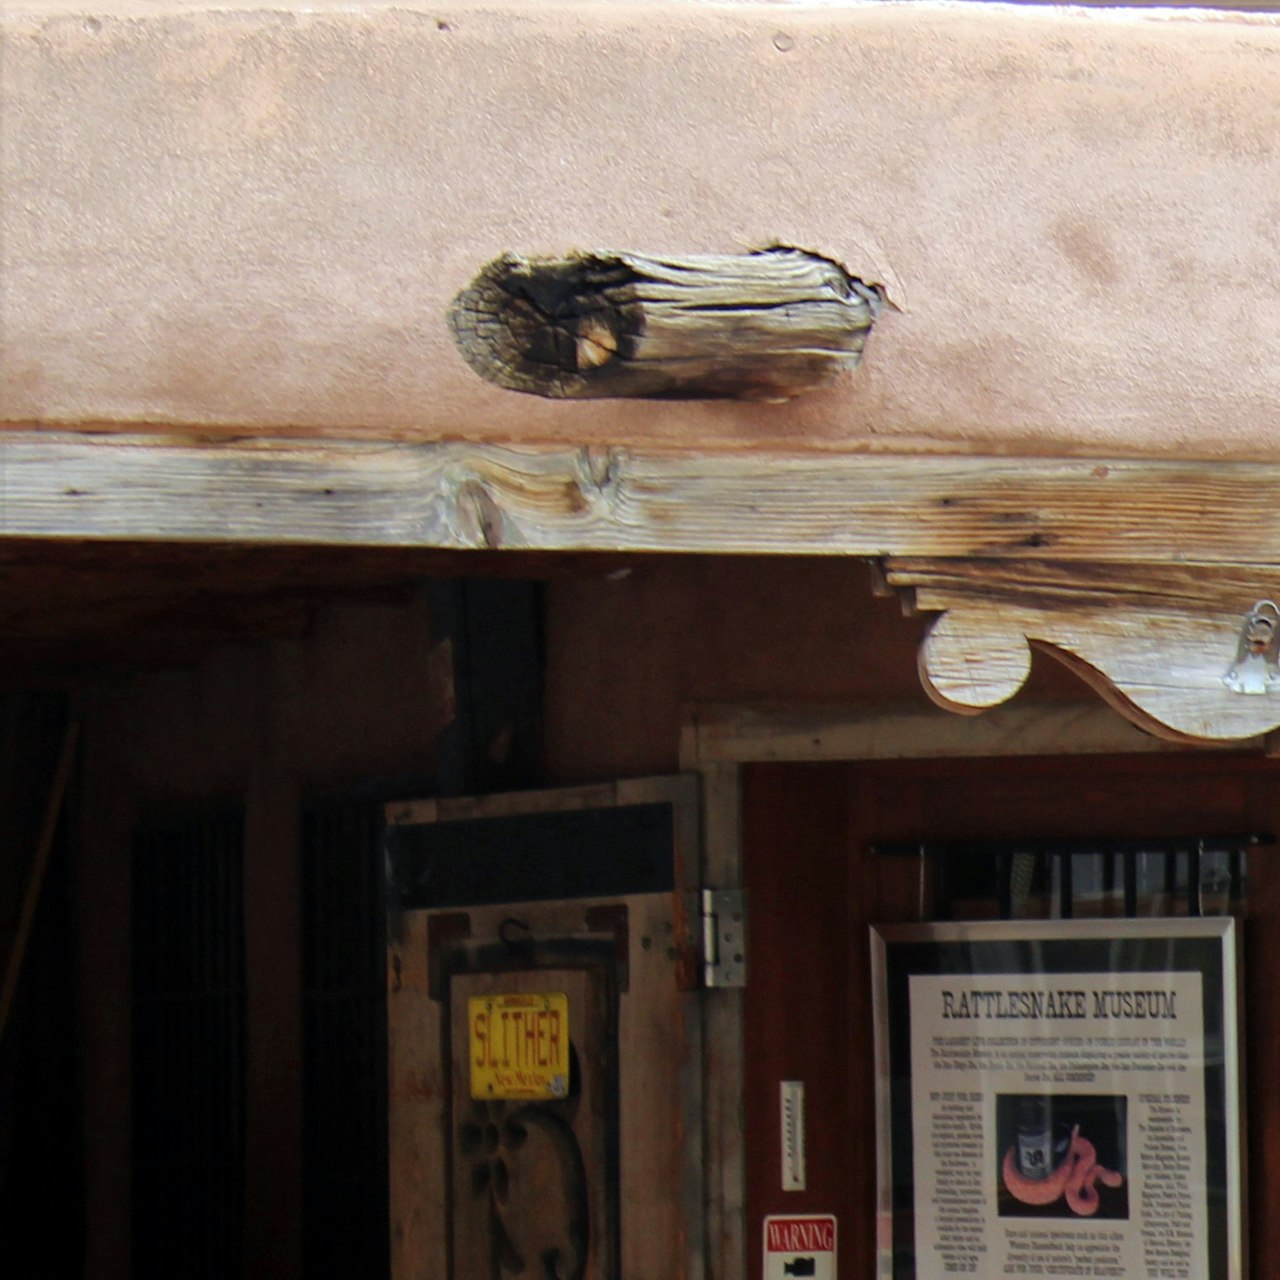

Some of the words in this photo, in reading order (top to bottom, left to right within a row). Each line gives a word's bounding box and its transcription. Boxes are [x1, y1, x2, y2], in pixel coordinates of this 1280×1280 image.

[942, 990, 1087, 1019] RATTLESNAKE
[1093, 990, 1177, 1019] MUSEUM
[475, 1011, 560, 1067] SLITHER
[769, 1223, 833, 1250] WARNING
